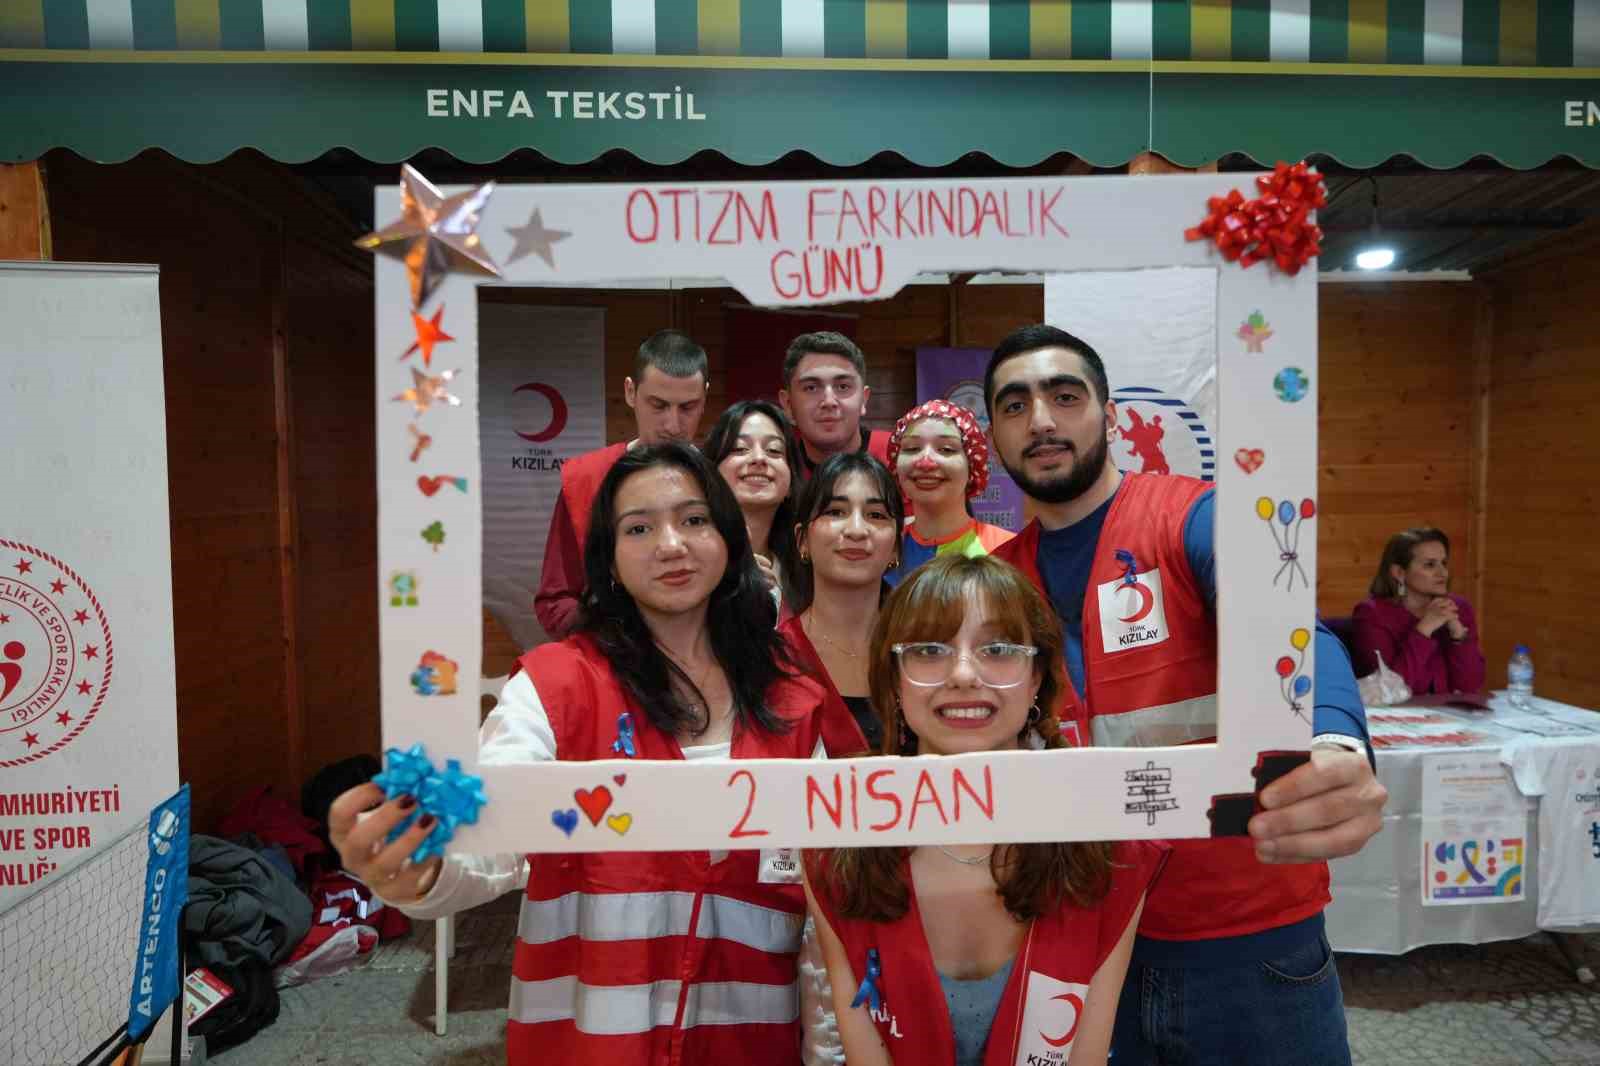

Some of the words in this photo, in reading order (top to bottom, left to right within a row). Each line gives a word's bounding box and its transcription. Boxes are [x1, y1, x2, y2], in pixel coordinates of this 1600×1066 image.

[426, 88, 534, 118] ENFA
[546, 85, 707, 120] TEKSTİL
[807, 185, 1070, 242] FARKINDALIK
[770, 242, 883, 300] GÜNÜ
[32, 598, 50, 617] VE
[46, 616, 68, 654] SPOR
[1118, 629, 1159, 646] KIZILAY
[10, 658, 68, 723] BAKANLIĞI
[0, 783, 120, 816] MHURİYETİ
[727, 769, 771, 839] 2
[806, 764, 995, 833] NİSAN
[0, 828, 25, 851] VE
[33, 826, 91, 850] SPOR
